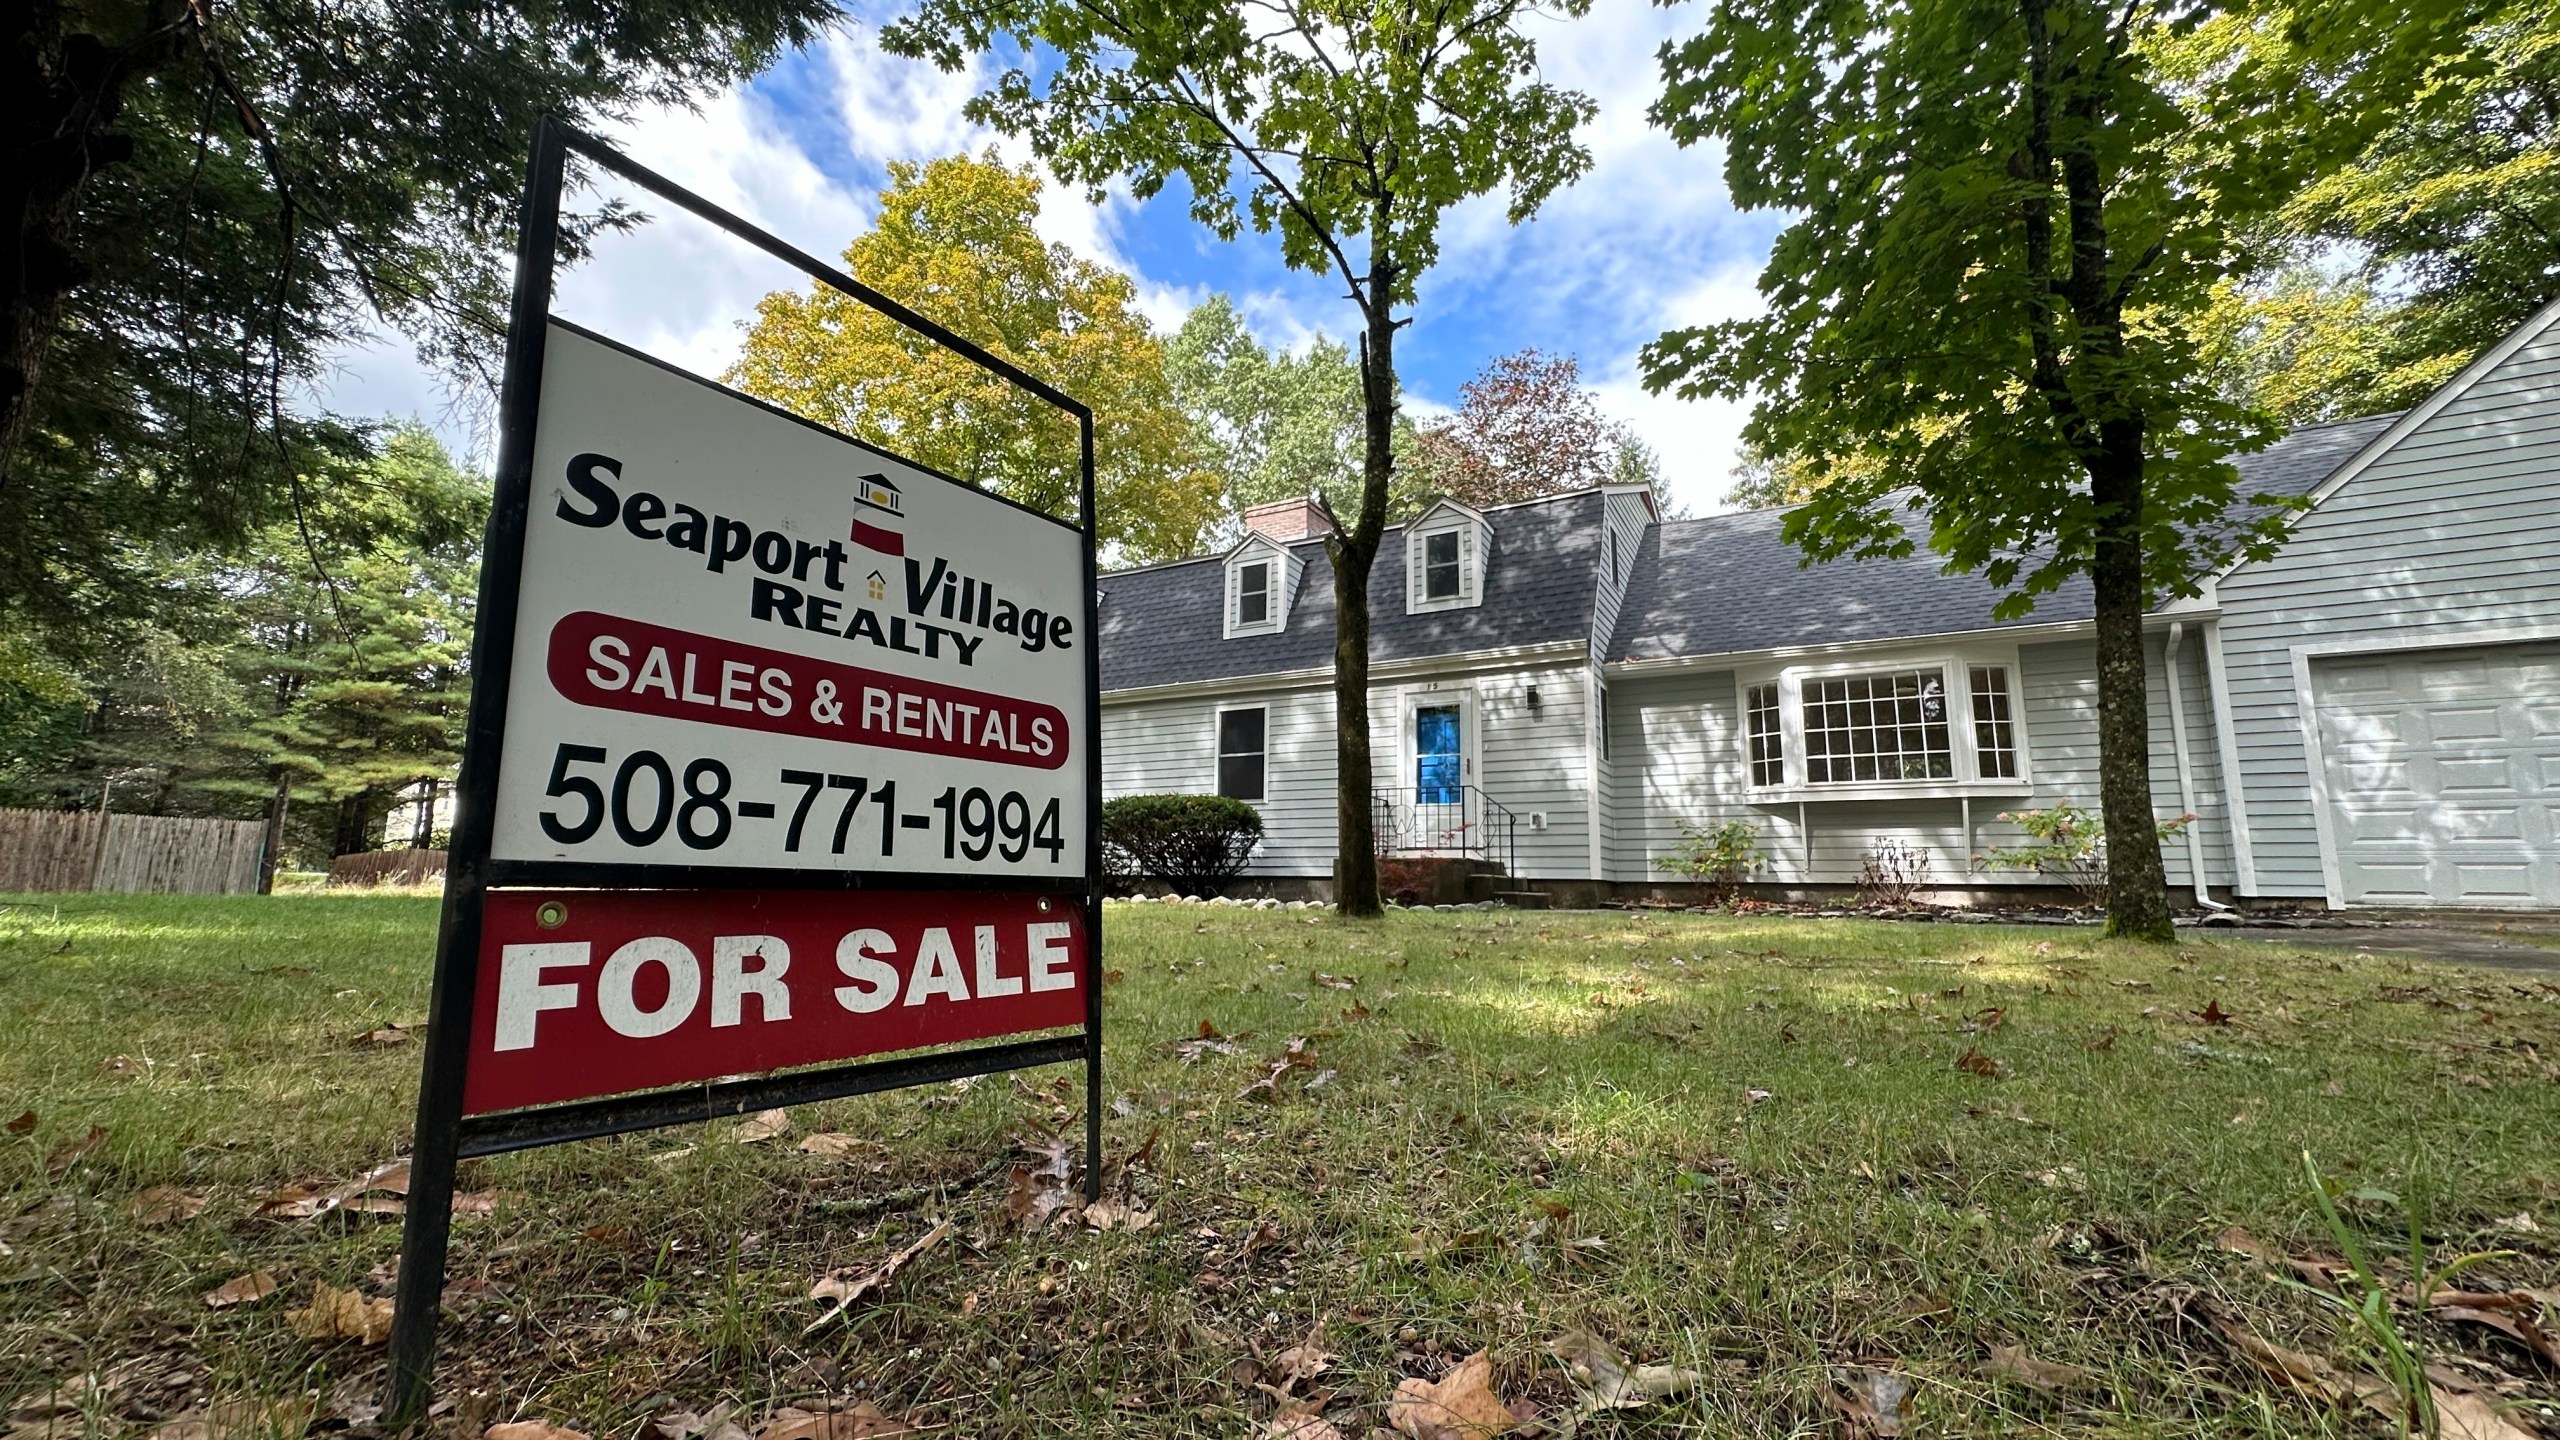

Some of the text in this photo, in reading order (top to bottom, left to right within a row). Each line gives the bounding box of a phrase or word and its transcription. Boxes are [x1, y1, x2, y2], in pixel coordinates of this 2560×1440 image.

[555, 453, 1073, 653] Seaport Village
[750, 577, 984, 667] REALTY
[585, 635, 1054, 756] SALES & RENTALS
[538, 743, 1065, 864] 508-771-1994
[494, 922, 1075, 1052] FOR SALE
